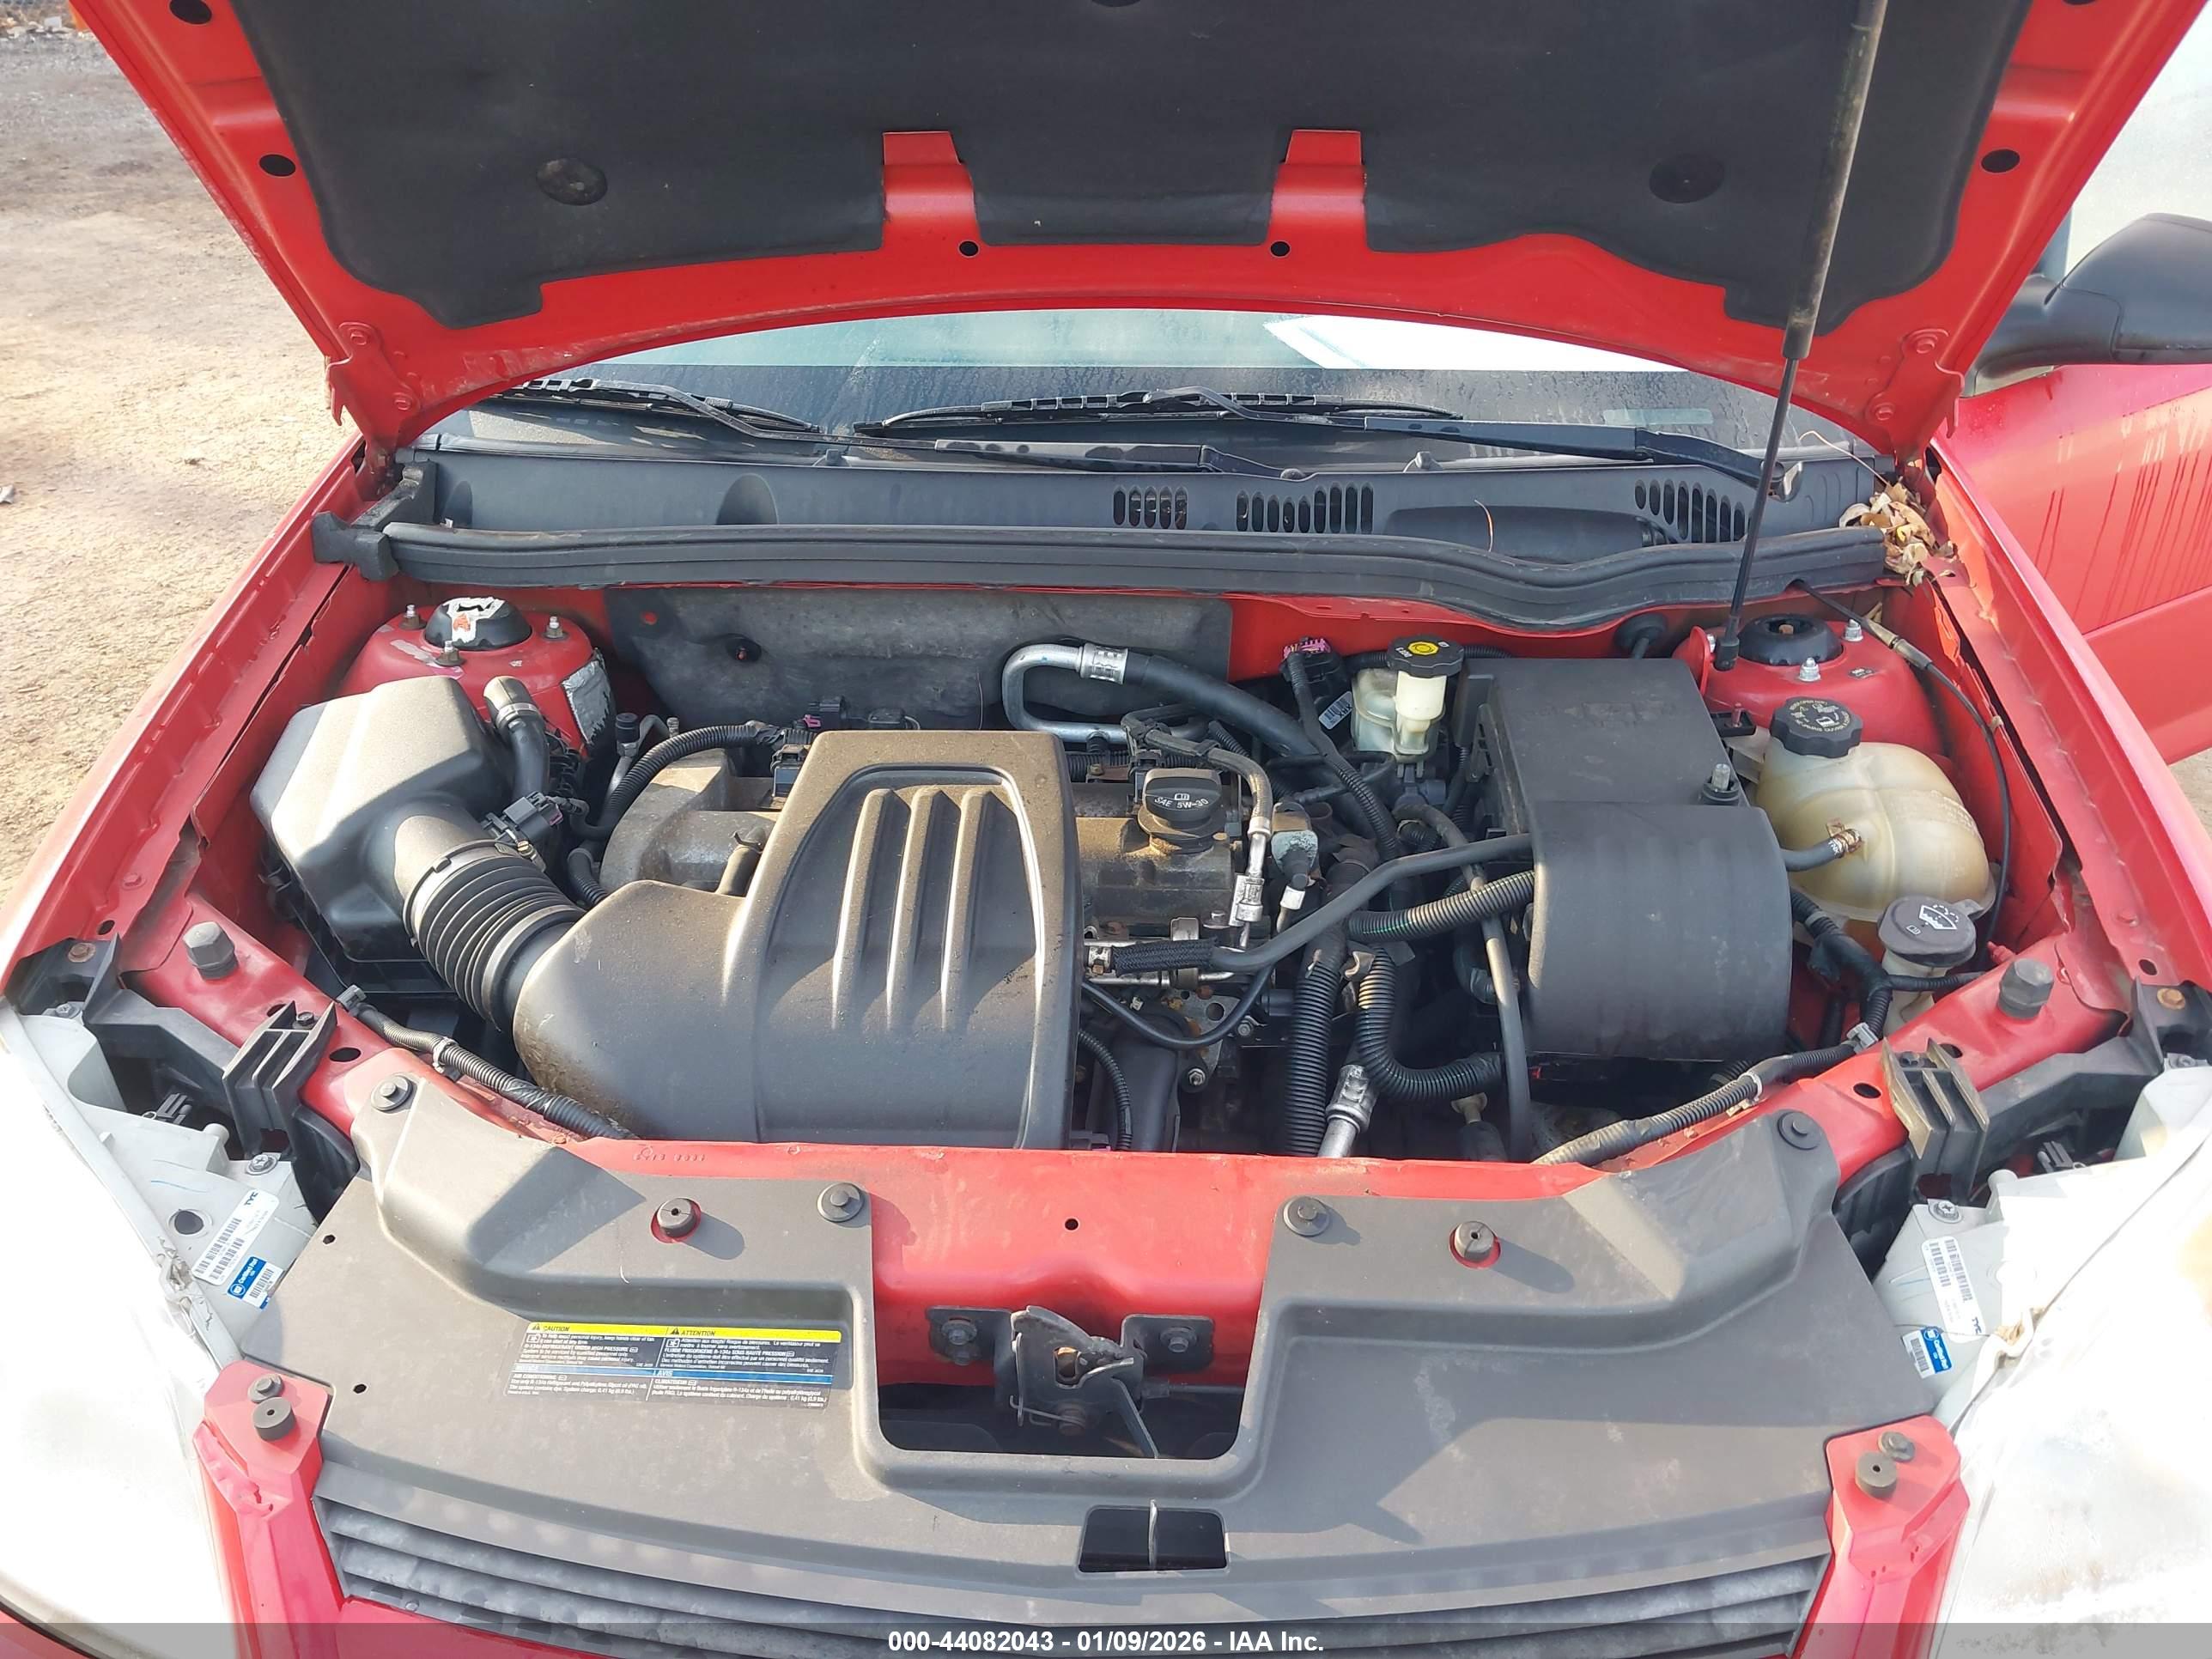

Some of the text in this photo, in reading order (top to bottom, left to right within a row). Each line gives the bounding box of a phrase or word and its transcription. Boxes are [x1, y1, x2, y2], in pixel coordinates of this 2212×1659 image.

[1154, 797, 1209, 809] SAE 5W-30
[244, 1191, 258, 1206] TYC
